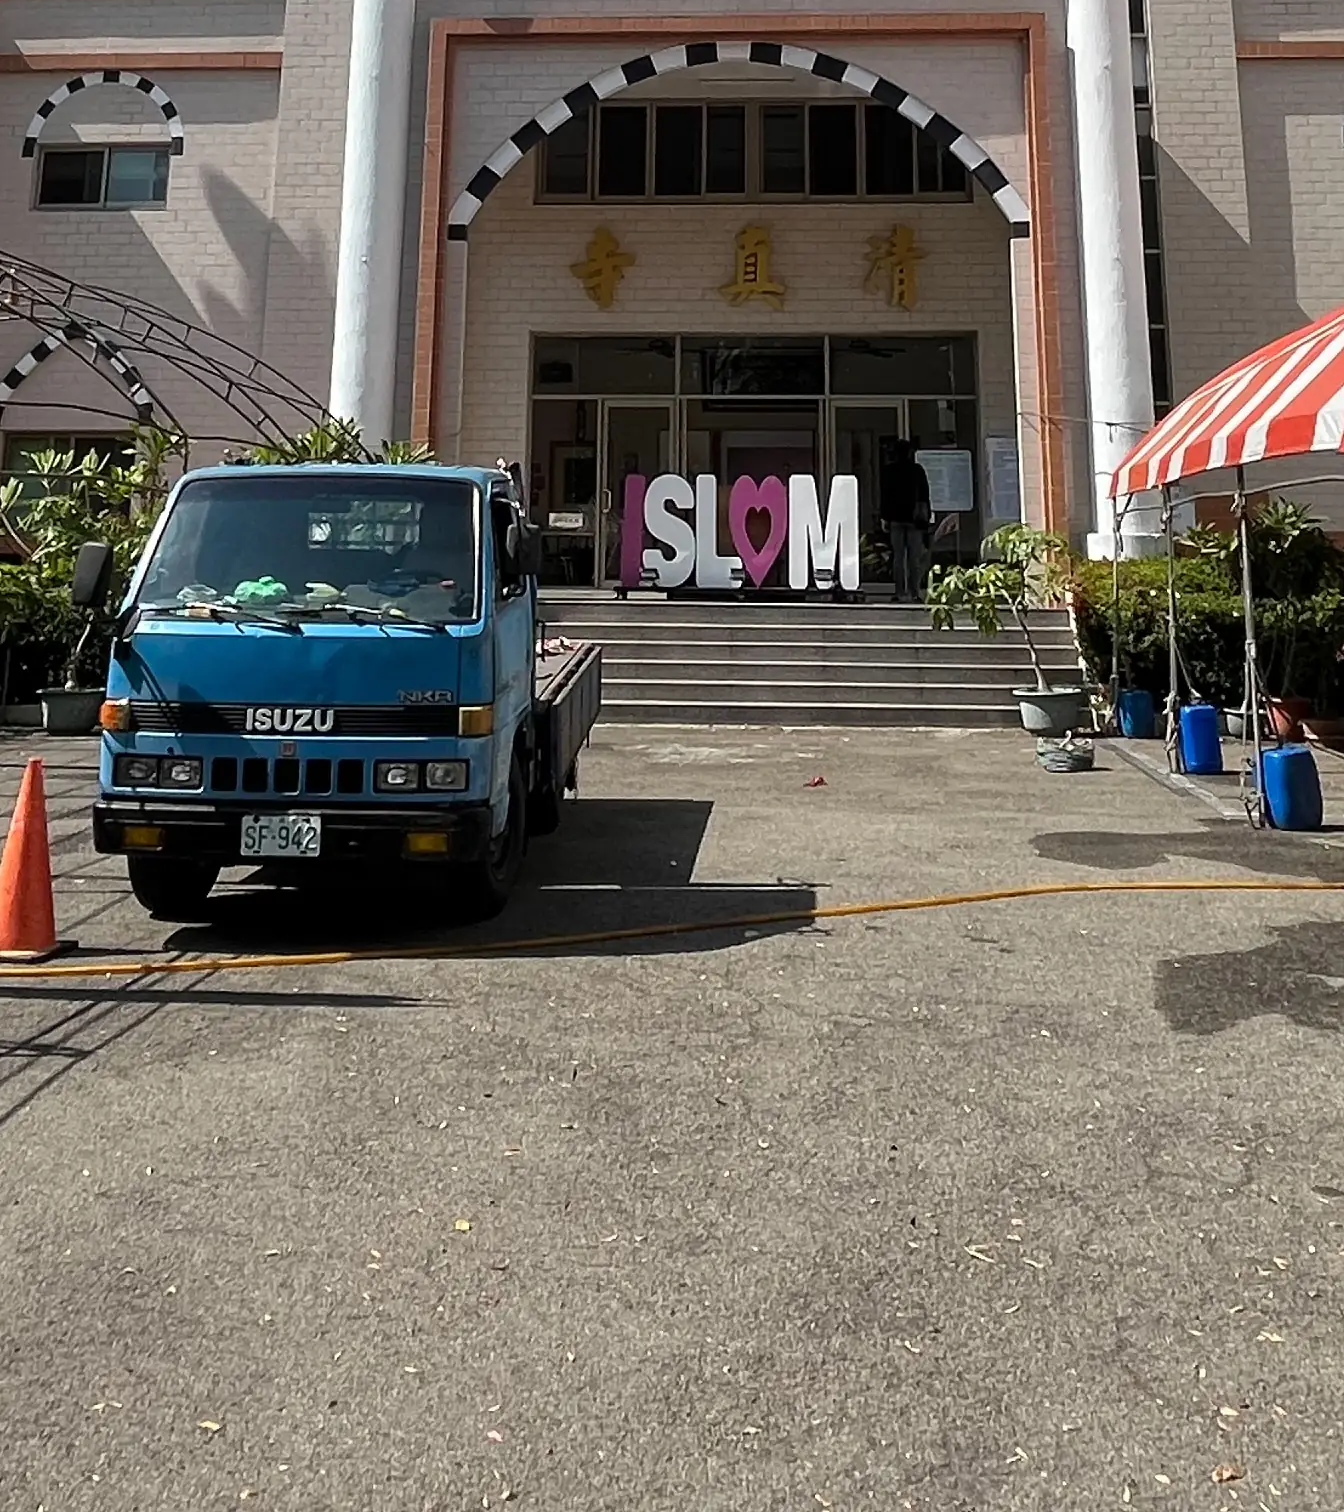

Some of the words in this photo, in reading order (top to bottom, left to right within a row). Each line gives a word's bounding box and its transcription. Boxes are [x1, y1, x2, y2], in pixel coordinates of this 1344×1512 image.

[620, 473, 860, 590] ISLM
[244, 707, 335, 732] ISUZU
[244, 824, 318, 850] SF-942
